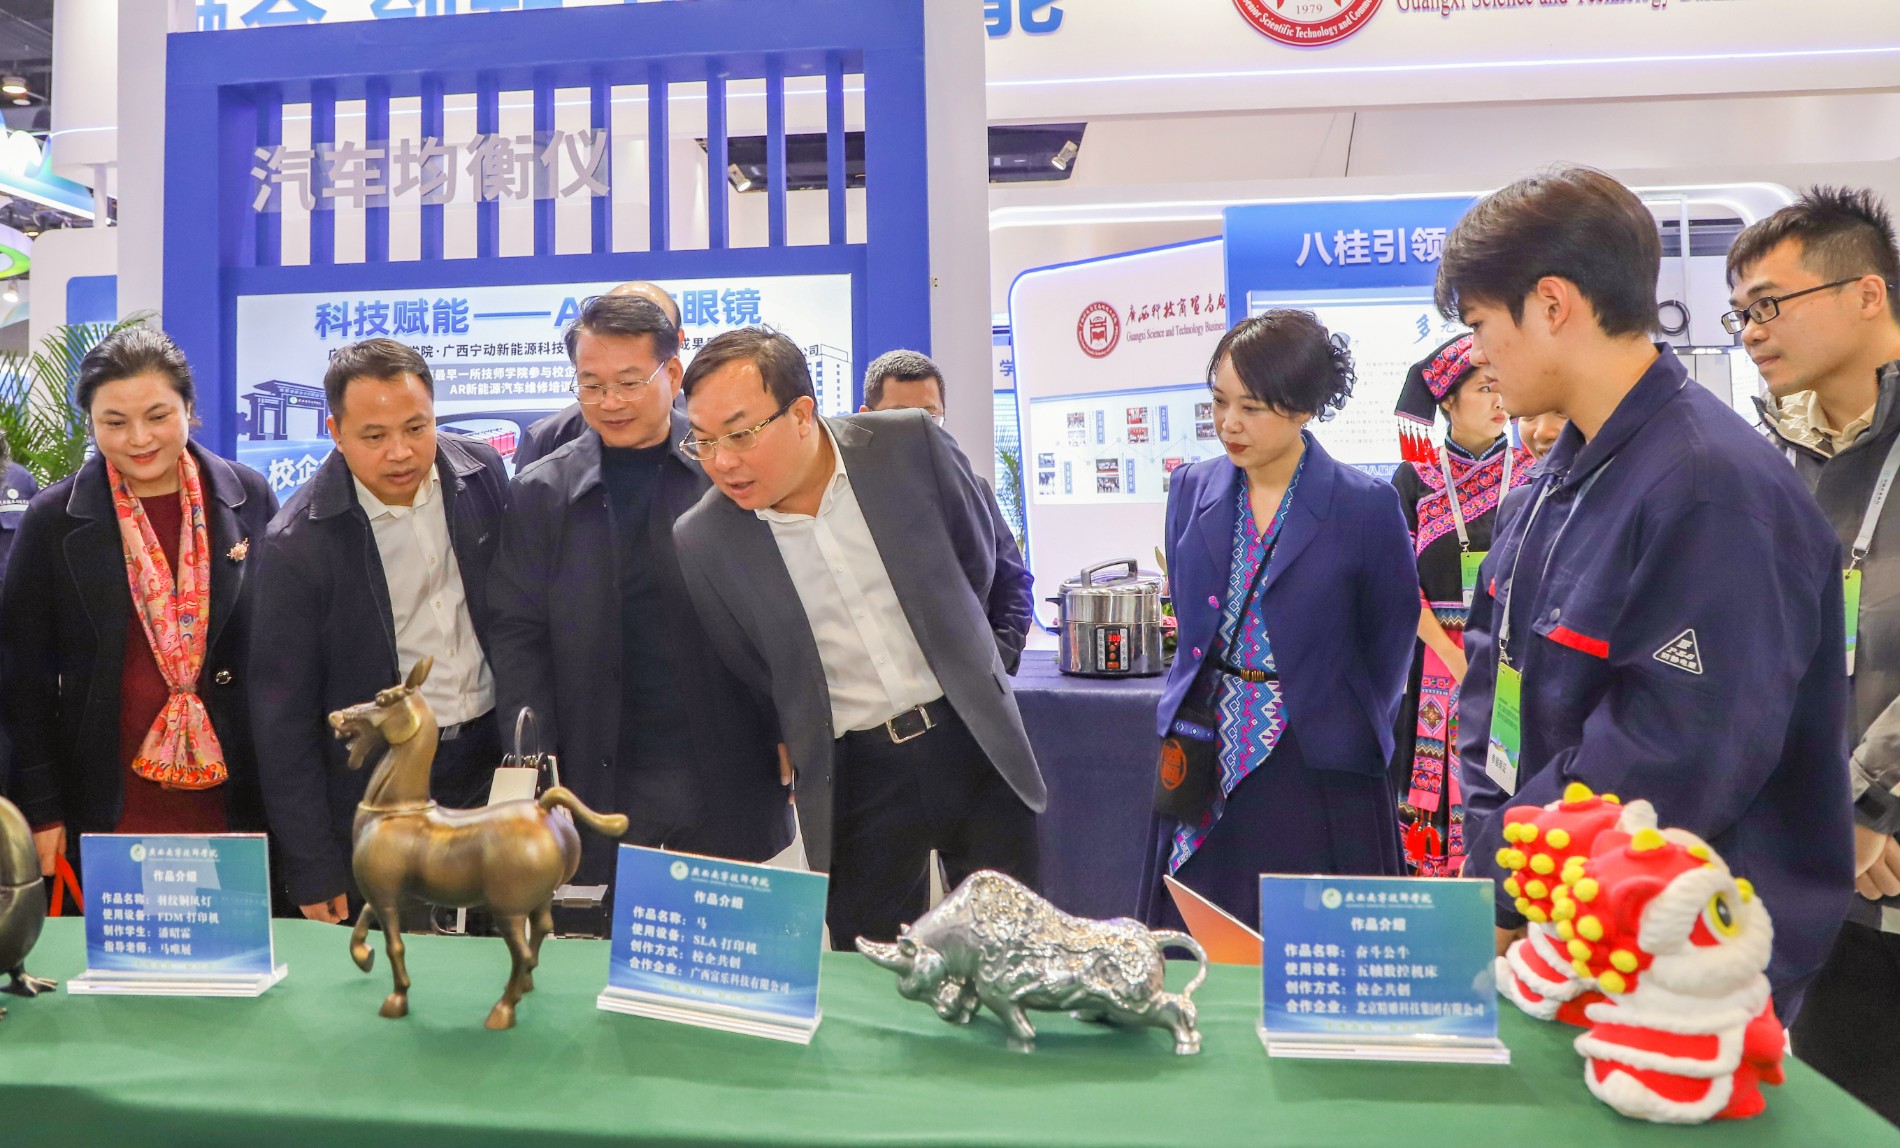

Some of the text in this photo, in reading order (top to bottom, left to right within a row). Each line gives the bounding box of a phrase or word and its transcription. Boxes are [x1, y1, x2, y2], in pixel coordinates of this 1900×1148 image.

[1296, 5, 1322, 15] 1979
[1260, 12, 1294, 36] Scientific
[1296, 25, 1338, 38] Technology
[1338, 15, 1352, 30] and
[250, 129, 611, 212] 汽车均衡仪
[1296, 227, 1447, 267] 八桂引领
[1147, 328, 1165, 338] Science
[1166, 326, 1174, 337] and
[1175, 323, 1204, 336] Technology
[431, 366, 575, 381] 最早一所技师学院参与校企
[450, 381, 579, 396] AR新能源汽车维修培训
[268, 451, 332, 492] 校企
[154, 870, 197, 882] 作品介绍
[102, 892, 149, 904] 作品名称：
[694, 890, 744, 910] 作品介绍
[103, 908, 219, 924] 使用设备： FDM 打印机
[633, 906, 707, 930] 作品名称： 马
[1351, 917, 1406, 932] 作品介绍
[632, 923, 758, 955] 使用设备： SLA 打印机
[1285, 943, 1346, 958] 作品名称：
[630, 956, 682, 976] 合作企业：
[692, 950, 741, 969] 校企共创
[1285, 962, 1346, 976] 使用设备：
[1286, 1000, 1346, 1014] 合作企业：
